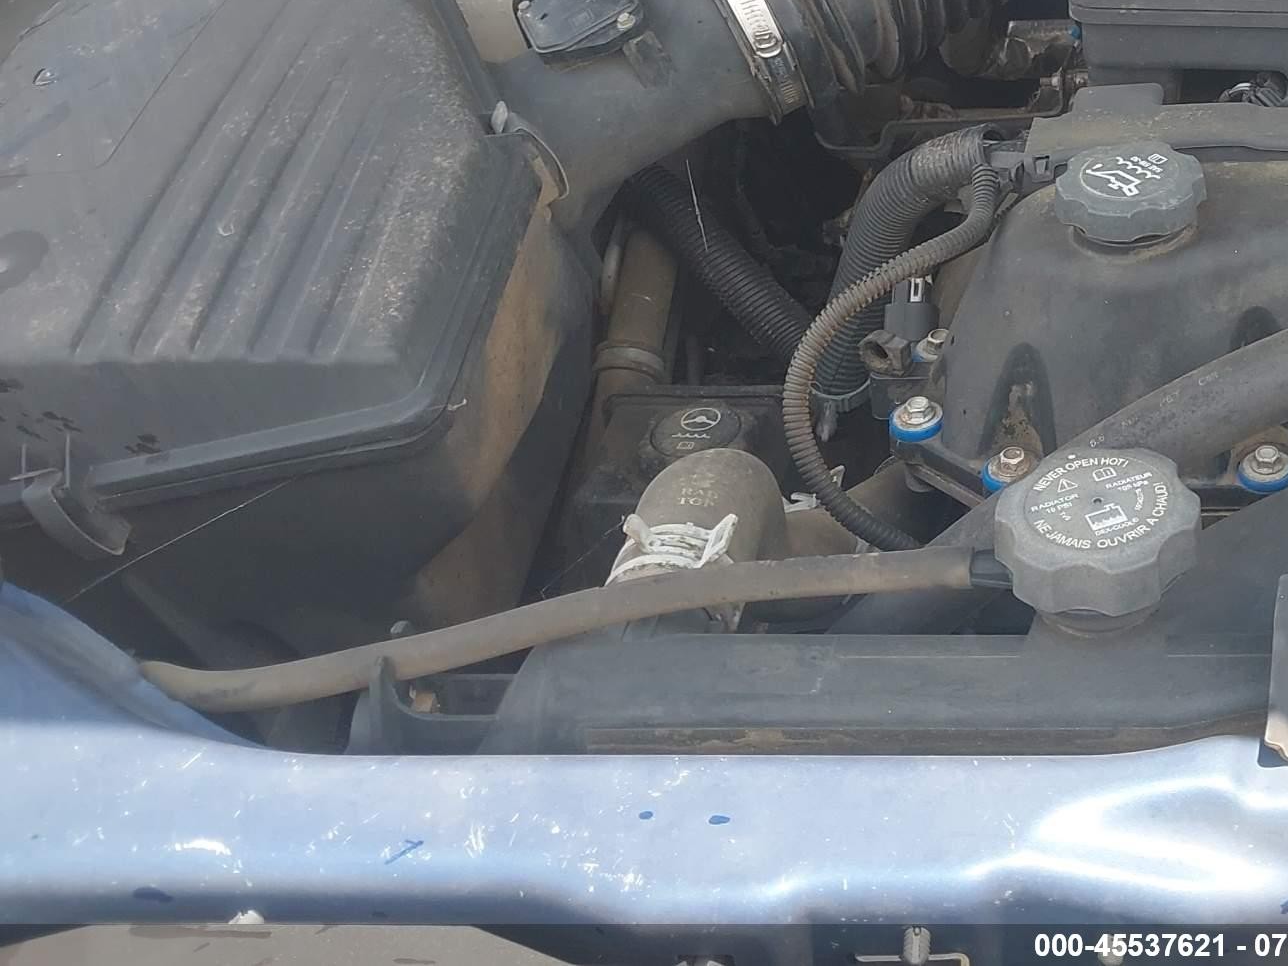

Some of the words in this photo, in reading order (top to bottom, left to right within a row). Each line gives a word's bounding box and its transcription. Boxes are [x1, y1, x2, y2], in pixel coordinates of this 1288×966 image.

[1033, 466, 1068, 492] NEVER
[1065, 457, 1099, 471] OPEN
[1100, 456, 1129, 468] HOT!
[1031, 493, 1080, 512] RADIATOR
[1033, 518, 1051, 534] NE
[1046, 530, 1092, 549] JAMAIS
[1096, 524, 1152, 549] OUVRIR
[1151, 481, 1169, 518] CHAUD!
